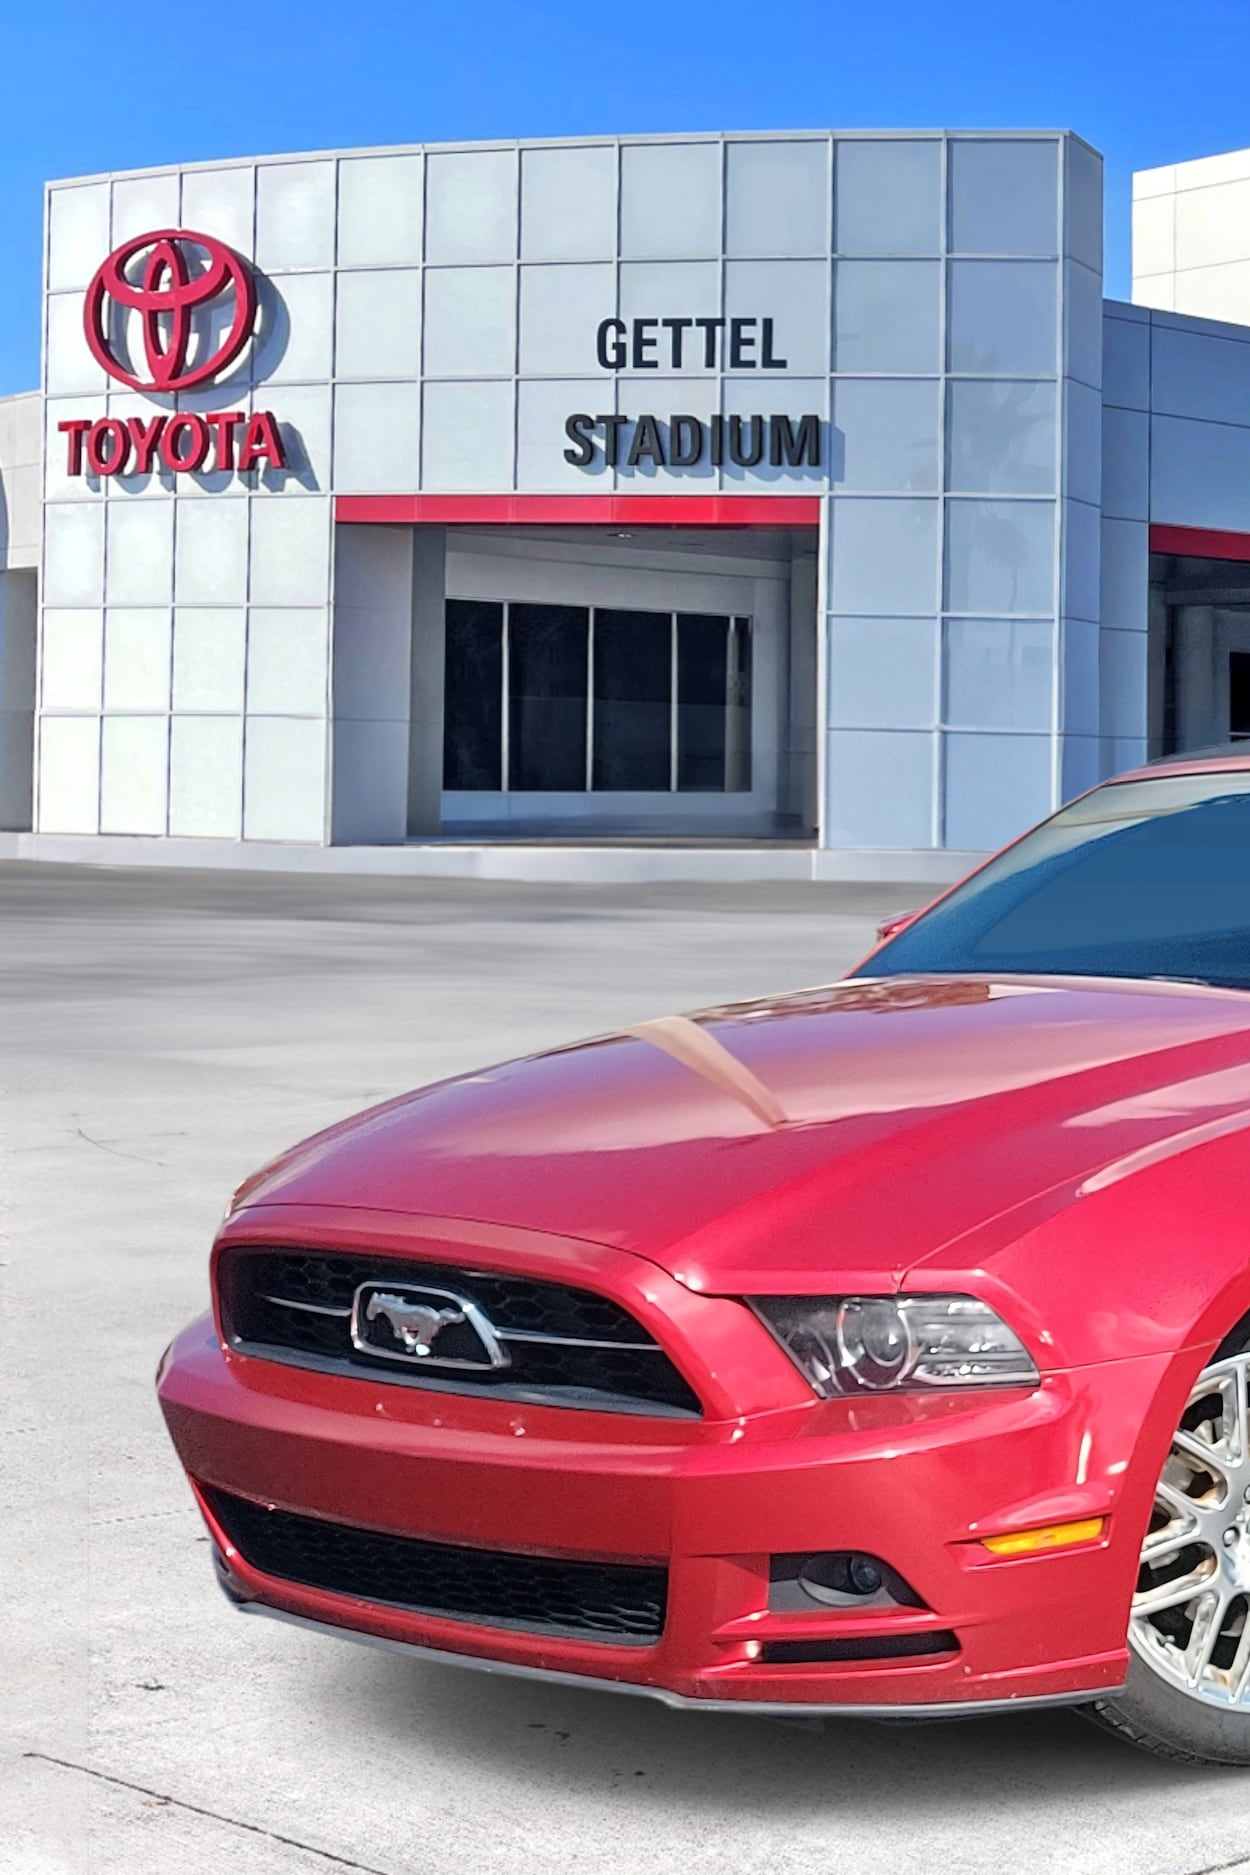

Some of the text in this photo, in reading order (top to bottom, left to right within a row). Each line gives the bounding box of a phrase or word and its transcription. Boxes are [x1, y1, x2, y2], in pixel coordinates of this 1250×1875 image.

[597, 317, 787, 369] GETTEL
[58, 411, 286, 476] TOYOTA
[564, 414, 820, 467] STADIUM
